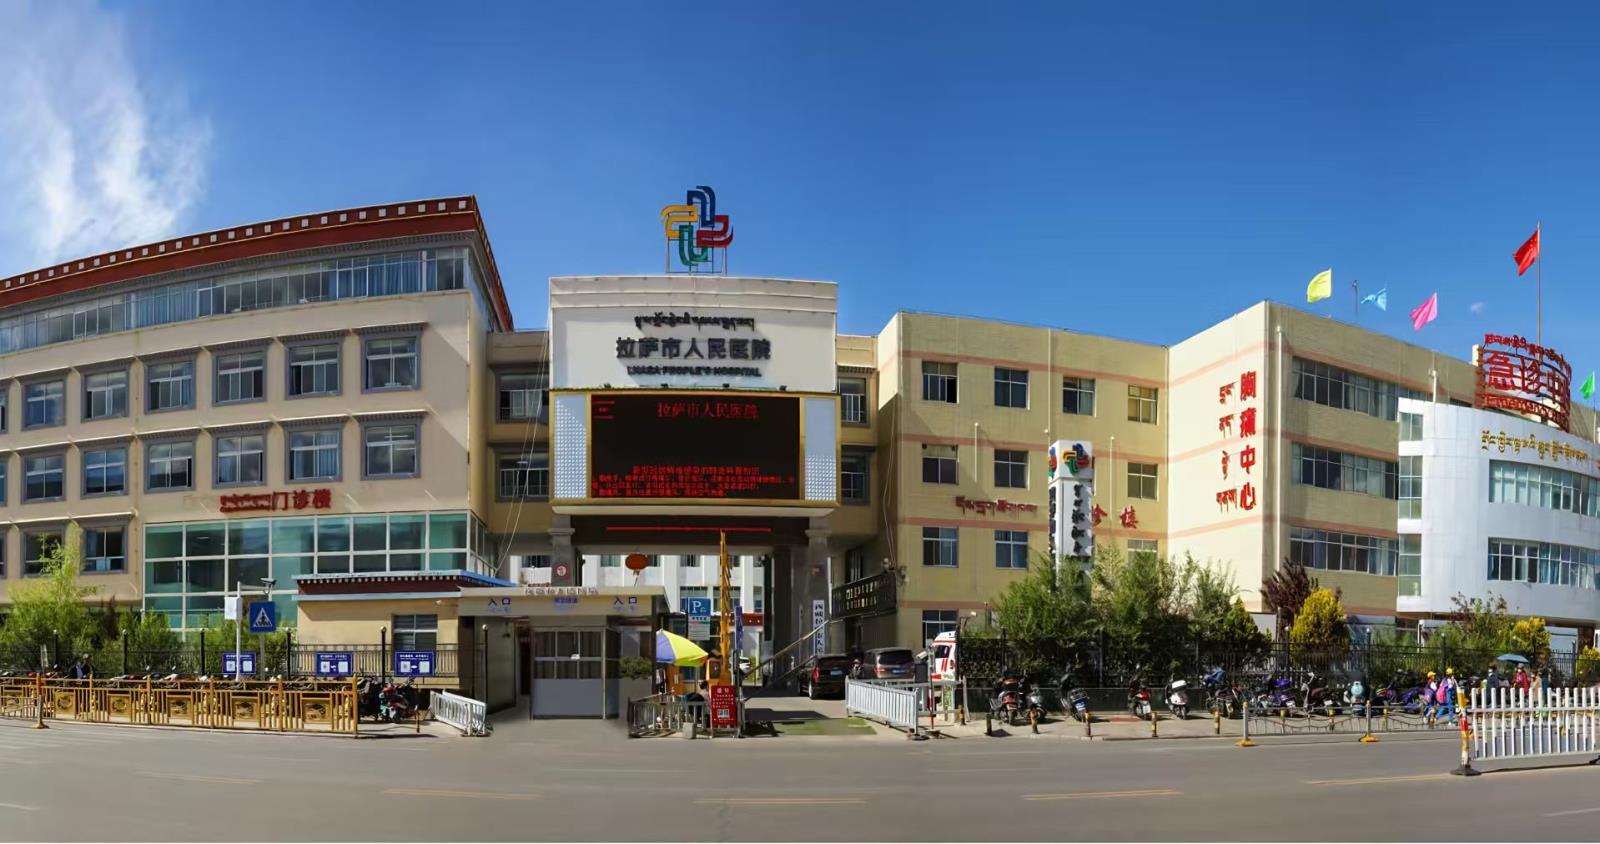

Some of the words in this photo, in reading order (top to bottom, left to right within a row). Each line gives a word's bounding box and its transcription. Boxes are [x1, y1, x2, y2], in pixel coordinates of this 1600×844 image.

[616, 337, 770, 360] 拉萨市人民医院
[627, 366, 661, 376] LHASA
[662, 366, 711, 377] PEOPLE'S
[713, 367, 762, 378] HOSPITAL
[657, 401, 760, 419] 拉萨市人民医院
[1240, 371, 1257, 511] 胸痛中心
[272, 489, 332, 511] 门诊楼
[488, 597, 511, 606] 入口
[614, 597, 638, 605] 入口
[692, 600, 702, 613] P
